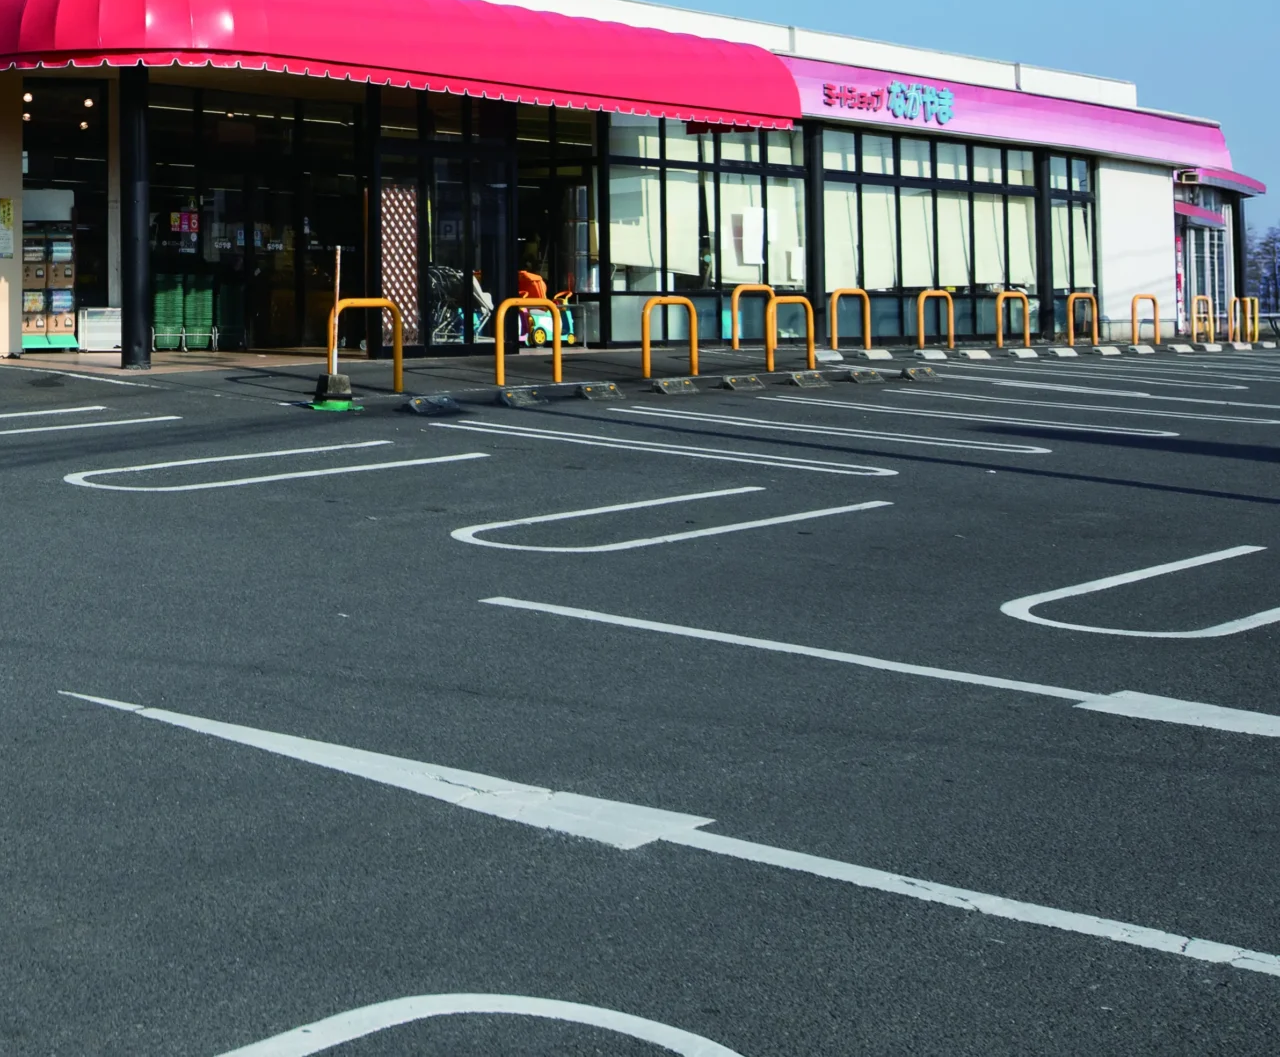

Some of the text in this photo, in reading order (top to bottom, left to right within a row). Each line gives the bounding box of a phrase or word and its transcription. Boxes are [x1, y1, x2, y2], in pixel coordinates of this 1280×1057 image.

[823, 83, 885, 112] ミートショップ
